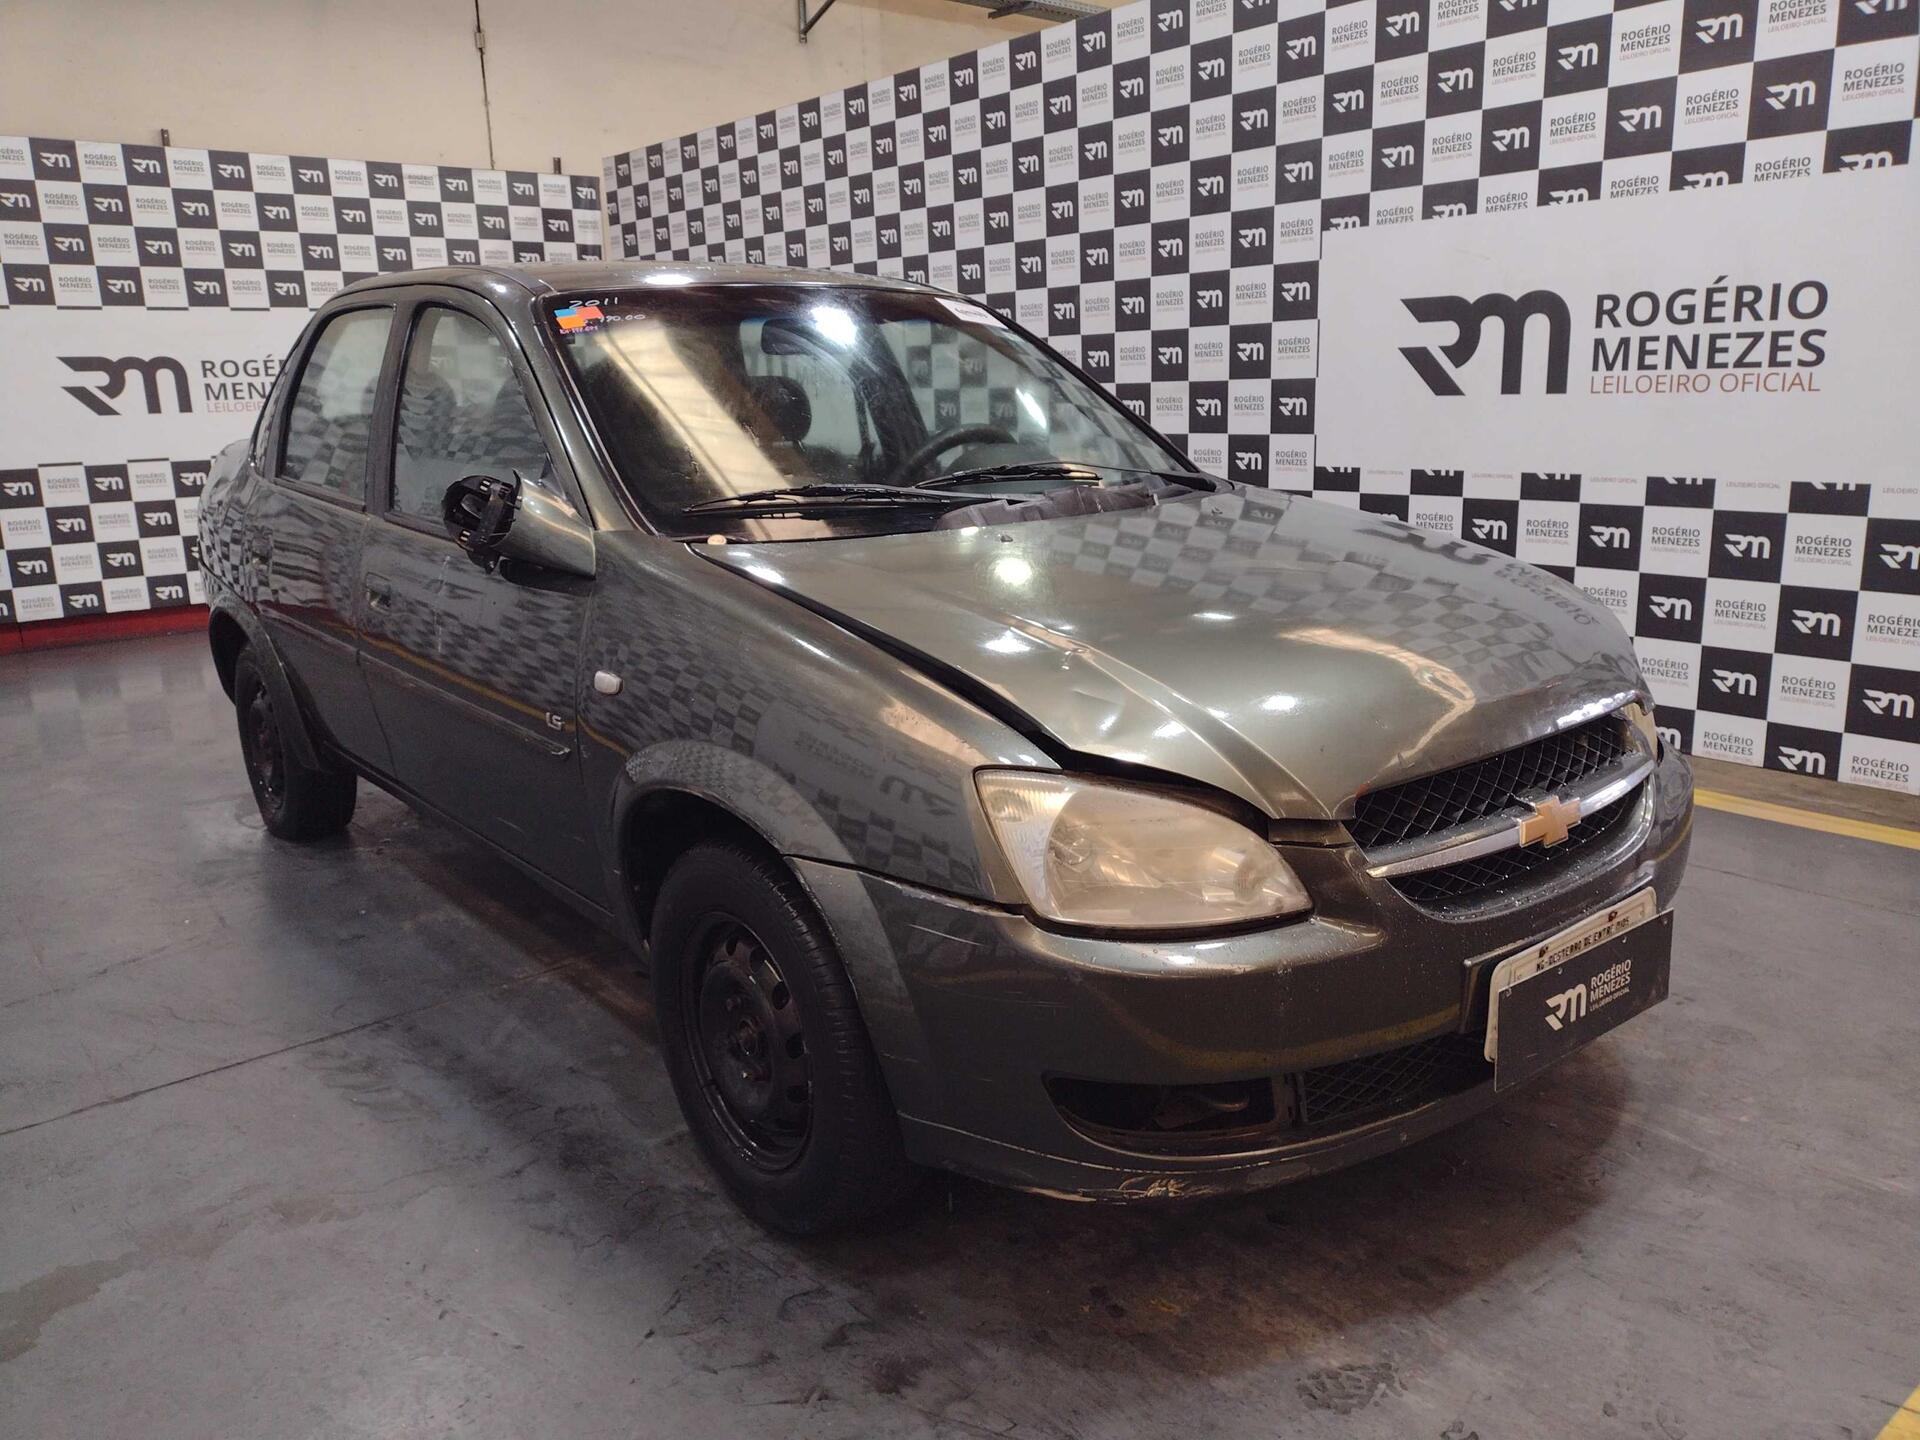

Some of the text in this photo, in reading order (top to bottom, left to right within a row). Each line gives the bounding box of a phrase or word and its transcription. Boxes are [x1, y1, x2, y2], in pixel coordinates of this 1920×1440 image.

[1768, 3, 1827, 24] MENEZES
[1117, 16, 1144, 30] ROGÉRIO
[1332, 18, 1367, 34] ROGÉRIO
[1117, 24, 1144, 38] MENEZES
[1332, 28, 1368, 44] MENEZES
[1621, 23, 1670, 42] ROGÉRIO
[1239, 42, 1270, 57] ROGÉRIO
[1620, 34, 1670, 52] MENEZES
[1239, 51, 1270, 66] MENEZES
[1492, 50, 1535, 67] ROGÉRIO
[1156, 63, 1184, 77] ROGÉRIO
[1492, 61, 1535, 77] MENEZES
[1844, 61, 1906, 80] ROGÉRIO
[1156, 72, 1184, 85] MENEZES
[1381, 74, 1418, 89] ROGÉRIO
[1842, 73, 1905, 92] MENEZES
[1380, 84, 1418, 98] MENEZES
[1686, 88, 1738, 105] ROGÉRIO
[1283, 95, 1316, 108] ROGÉRIO
[1685, 99, 1738, 116] MENEZES
[1282, 104, 1316, 117] MENEZES
[1196, 113, 1225, 126] ROGÉRIO
[1550, 111, 1595, 127] ROGÉRIO
[1196, 122, 1225, 134] MENEZES
[1549, 122, 1595, 137] MENEZES
[1432, 131, 1471, 145] ROGÉRIO
[1431, 141, 1471, 155] MENEZES
[1328, 149, 1363, 162] ROGÉRIO
[1237, 165, 1268, 177] ROGÉRIO
[1328, 158, 1363, 171] MENEZES
[1237, 174, 1268, 185] MENEZES
[1610, 175, 1659, 189] ROGÉRIO
[1280, 218, 1312, 229] ROGÉRIO
[1195, 230, 1224, 240] ROGÉRIO
[1280, 227, 1312, 238] MENEZES
[1195, 238, 1224, 248] MENEZES
[1236, 282, 1266, 292] ROGÉRIO
[1236, 291, 1266, 300] MENEZES
[1595, 275, 1828, 329] ROGÉRIO
[569, 297, 618, 310] 2011
[1278, 336, 1309, 346] ROGÉRIO
[1278, 346, 1309, 354] MENEZES
[1592, 328, 1827, 372] MENEZES
[1589, 371, 1821, 395] LEILOEIRO OFICIAL
[204, 382, 274, 401] MEN
[1234, 394, 1263, 402] ROGÉRIO
[1275, 449, 1306, 458] ROGÉRIO
[1526, 518, 1568, 529] ROGÉRIO
[1525, 528, 1568, 538] MENEZES
[1652, 526, 1700, 537] ROGÉRIO
[1651, 536, 1700, 547] MENEZES
[1796, 535, 1851, 547] ROGÉRIO
[1794, 545, 1851, 557] MENEZES
[1715, 599, 1766, 612] ROGÉRIO
[1714, 609, 1766, 622] MENEZES
[1641, 657, 1688, 671] ROGÉRIO
[1640, 667, 1688, 680] MENEZES
[1781, 675, 1835, 690] ROGÉRIO
[1780, 685, 1835, 700] MENEZES
[1703, 731, 1753, 747] ROGÉRIO
[1702, 741, 1752, 756] MENEZES
[1851, 755, 1908, 772] ROGÉRIO
[1849, 765, 1908, 782] MENEZES
[1591, 959, 1632, 990] ROGÉRIO
[1590, 972, 1631, 1002] MENEZES
